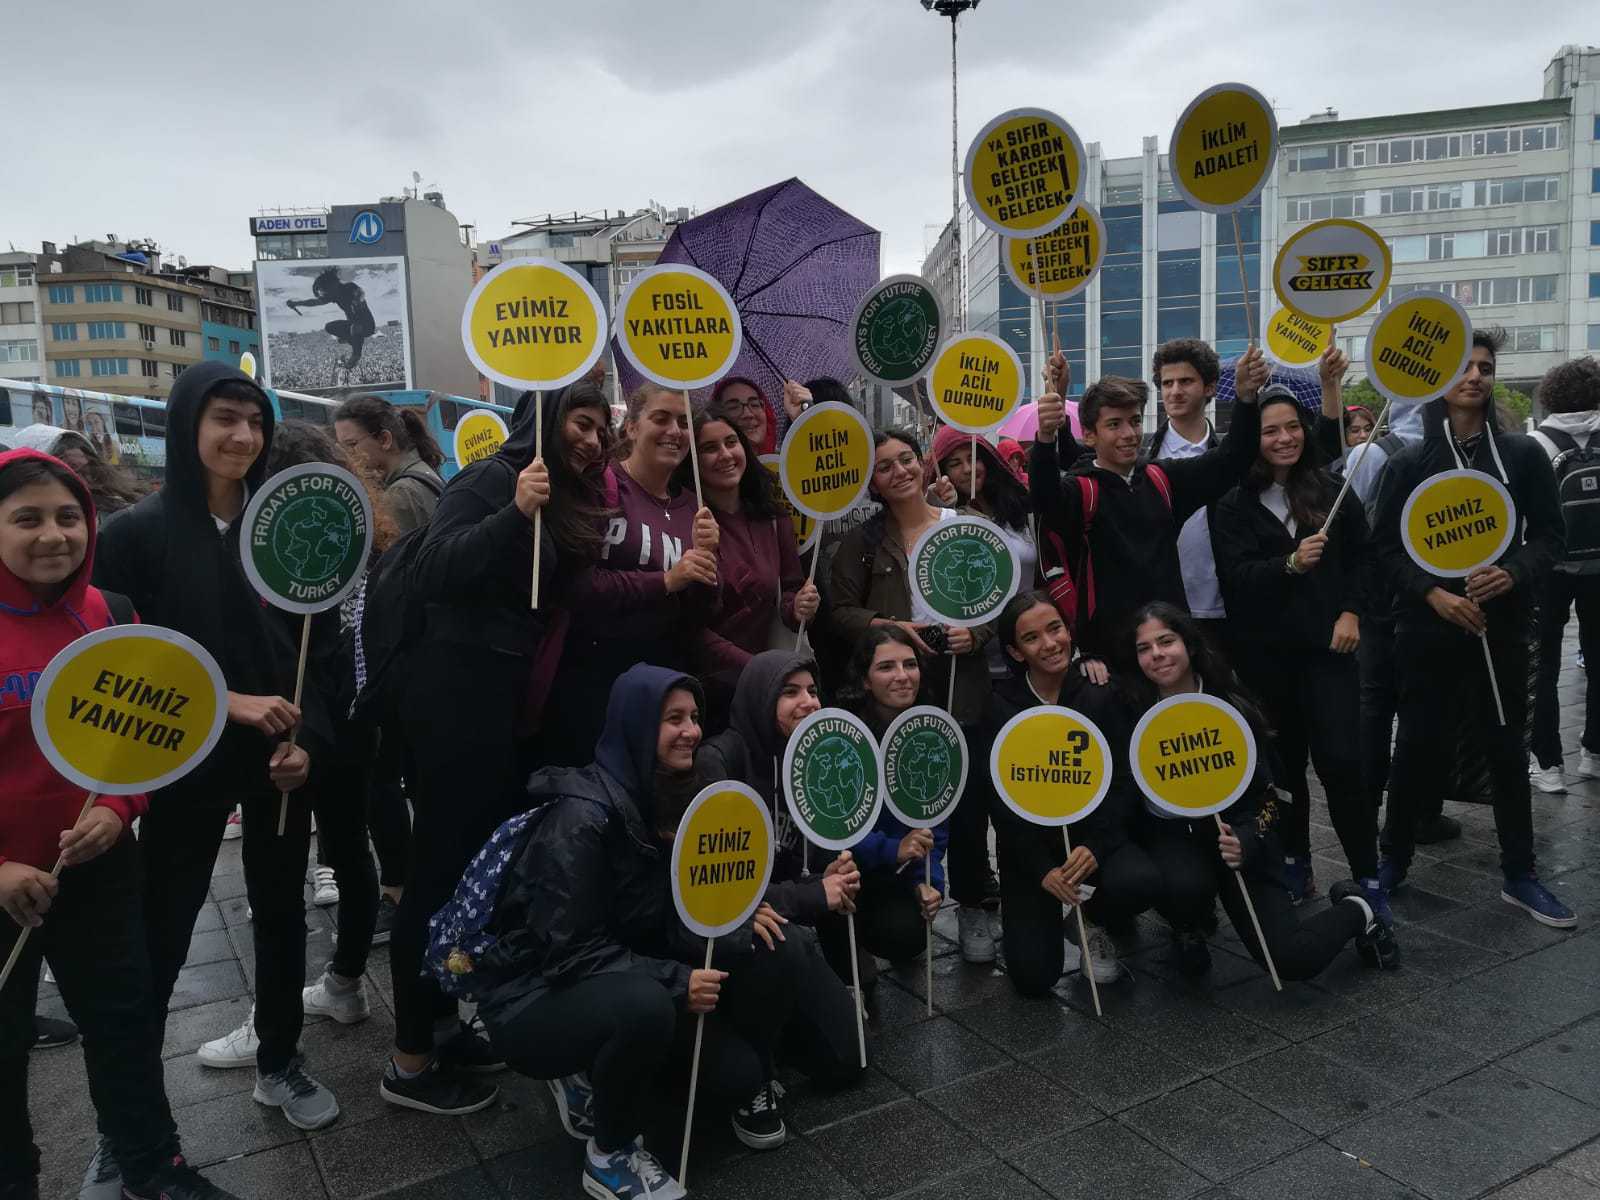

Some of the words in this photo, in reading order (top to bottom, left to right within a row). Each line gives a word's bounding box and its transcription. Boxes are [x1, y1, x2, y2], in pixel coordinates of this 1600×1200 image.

[988, 139, 1003, 152] YA
[1006, 122, 1049, 146] SIFIR
[1201, 121, 1246, 151] İKLİM
[998, 136, 1064, 168] KARBON
[1194, 139, 1258, 179] ADALETİ
[986, 195, 1002, 207] YA
[1005, 178, 1047, 202] SIFIR
[258, 219, 290, 230] ADEN
[294, 218, 325, 228] OTEL
[1037, 252, 1071, 269] SIFIR
[1307, 255, 1359, 271] SIFIR
[880, 283, 923, 303] FUTURE
[1295, 274, 1368, 290] GELECEK
[495, 296, 570, 321] EVİMİZ
[651, 289, 704, 311] FOSİL
[861, 300, 881, 326] FOR
[487, 326, 582, 348] YANIYOR
[628, 317, 731, 337] YAKITLARA
[1275, 322, 1318, 354] YANIYOR
[1408, 310, 1451, 345] İKLİM
[658, 341, 709, 360] VEDA
[858, 327, 883, 375] FRIDAYS
[911, 323, 937, 369] TURKEY
[1401, 335, 1435, 362] ACİL
[960, 351, 1000, 375] İKLİM
[1378, 346, 1441, 386] DURUMU
[960, 373, 993, 392] ACİL
[943, 388, 1005, 412] DURUMU
[808, 428, 849, 453] İKLİM
[815, 449, 847, 473] ACİL
[801, 468, 860, 496] DURUMU
[253, 482, 299, 547] FRIDAYS
[300, 476, 334, 492] FOR
[335, 482, 366, 536] FUTURE
[1425, 497, 1485, 529] EVİMİZ
[1423, 515, 1498, 550] YANIYOR
[919, 543, 937, 597] FRIDAYS
[933, 527, 959, 546] FOR
[960, 525, 1007, 554] FUTURE
[287, 572, 341, 599] TURKEY
[961, 584, 1004, 617] TURKEY
[92, 669, 191, 719] EVİMİZ
[67, 695, 186, 753] YANIYOR
[818, 719, 864, 745] FUTURE
[797, 727, 819, 756] FOR
[886, 734, 904, 794] FRIDAYS
[899, 717, 922, 738] FOR
[922, 716, 959, 749] FUTURE
[1158, 727, 1222, 757] EVİMİZ
[1010, 763, 1092, 785] İSTİYORUZ
[1154, 750, 1236, 781] YANIYOR
[792, 757, 816, 823] FRIDAYS
[920, 781, 955, 817] TURKEY
[843, 781, 876, 833] TURKEY
[698, 826, 752, 855] EVİMİZ
[689, 859, 756, 887] YANIYOR
